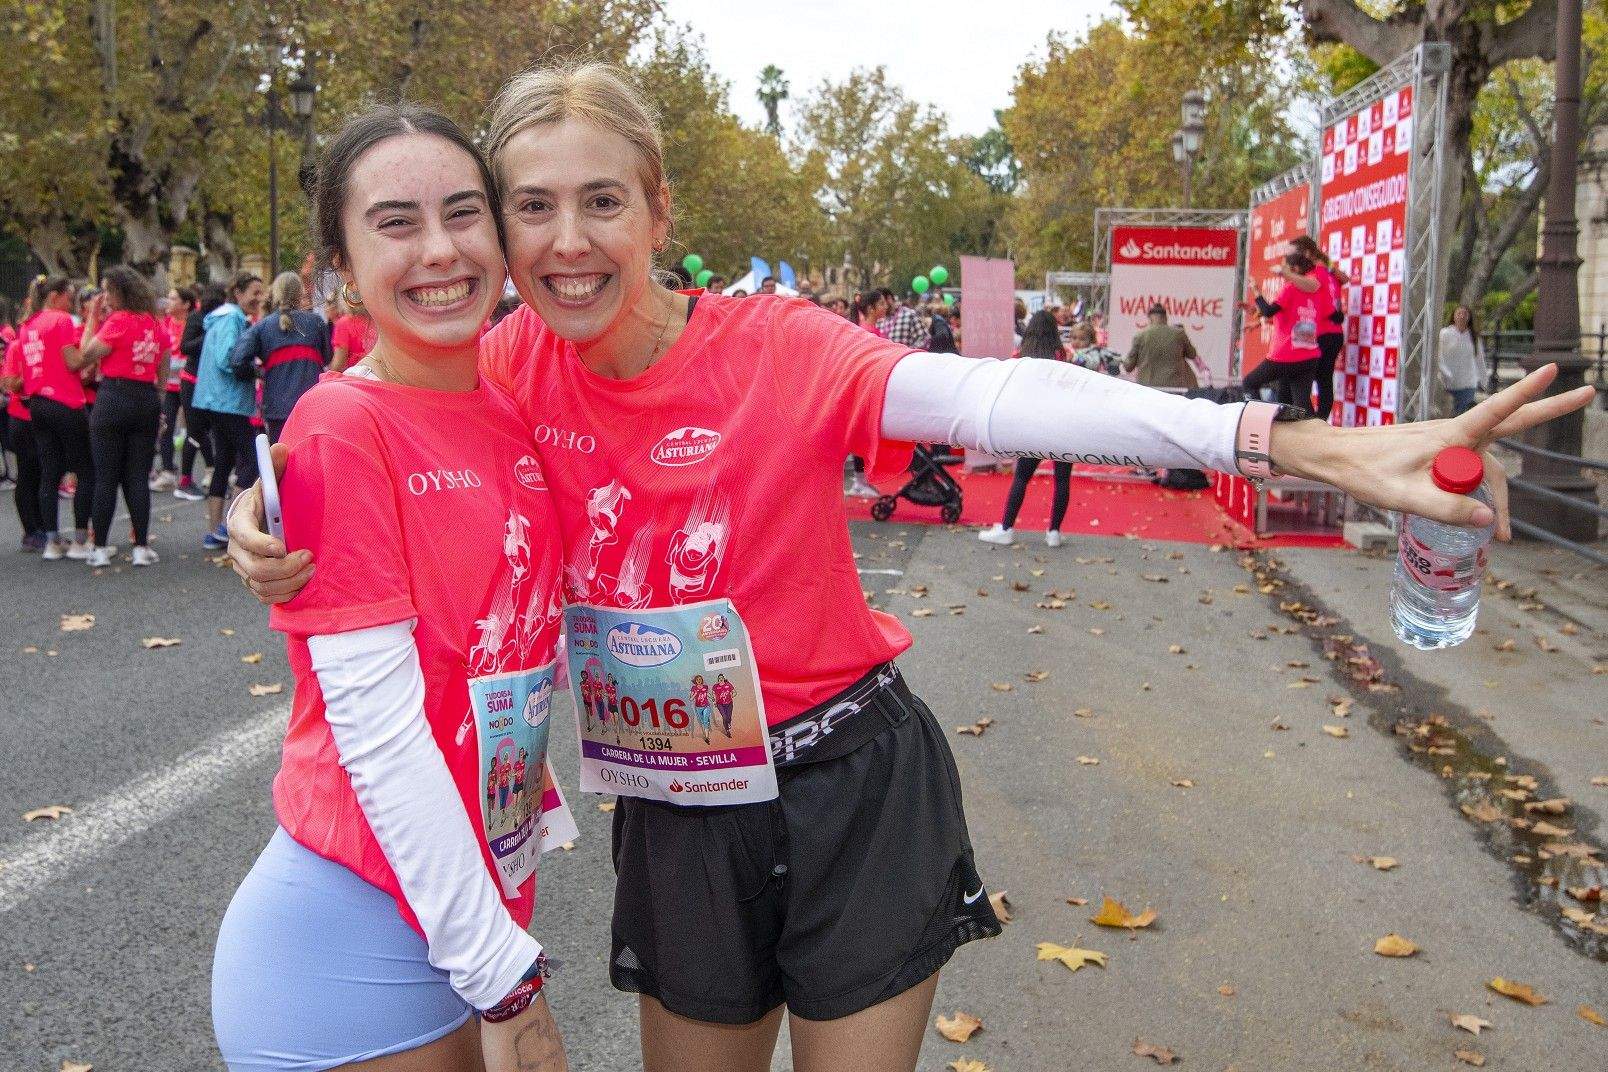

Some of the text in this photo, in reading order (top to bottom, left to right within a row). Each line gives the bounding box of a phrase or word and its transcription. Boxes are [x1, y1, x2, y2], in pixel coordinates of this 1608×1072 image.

[1143, 242, 1231, 260] Santander
[407, 468, 481, 496] OYSHO
[573, 622, 599, 635] SUMA
[611, 635, 677, 656] ASTURIANA
[487, 698, 513, 713] SUMA
[639, 736, 673, 751] 1394
[601, 747, 738, 767] CARRERA DE LA MUJER SEVILLA
[600, 767, 650, 789] OYSHO
[684, 778, 749, 793] Santander
